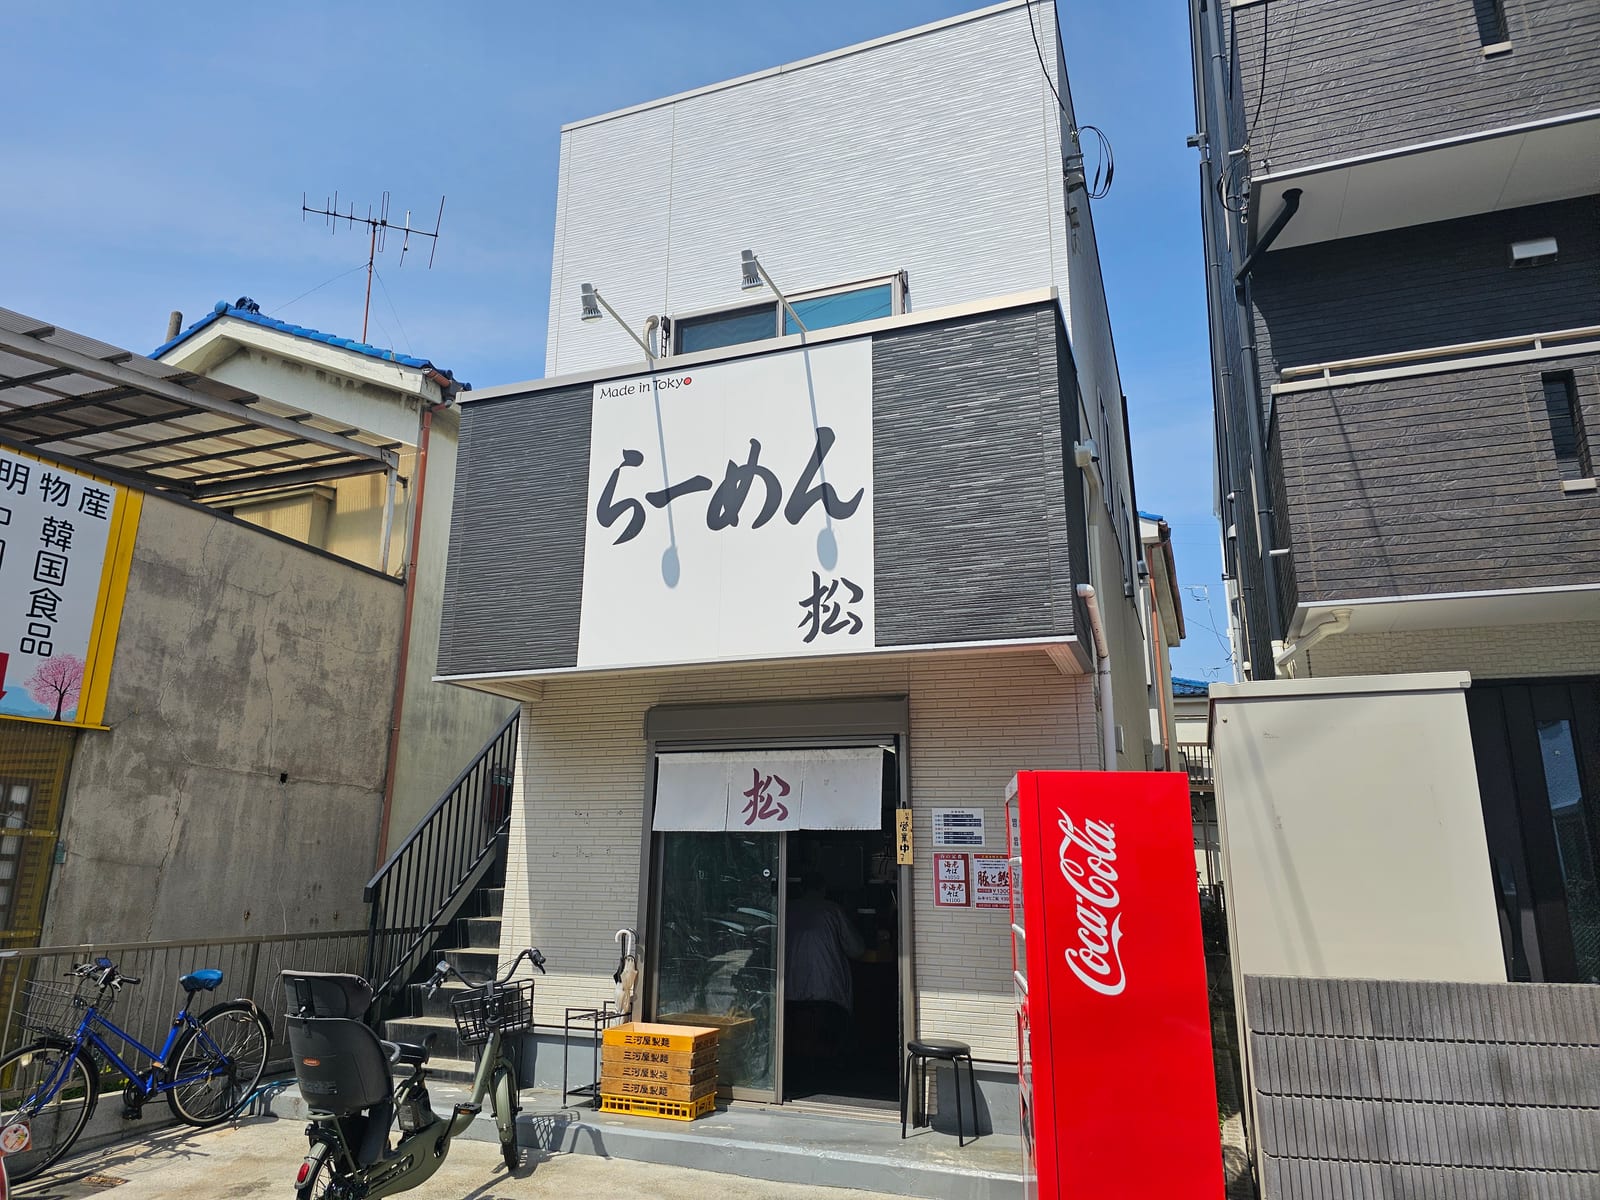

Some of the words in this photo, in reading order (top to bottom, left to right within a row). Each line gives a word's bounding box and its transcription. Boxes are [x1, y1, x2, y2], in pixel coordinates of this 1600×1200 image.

[600, 385, 635, 399] Made
[639, 382, 650, 393] in
[596, 426, 864, 545] らーめん
[20, 515, 75, 658] 韓国食品
[797, 571, 864, 643] 松
[741, 767, 791, 825] 松
[1057, 807, 1126, 996] Coca-Cola
